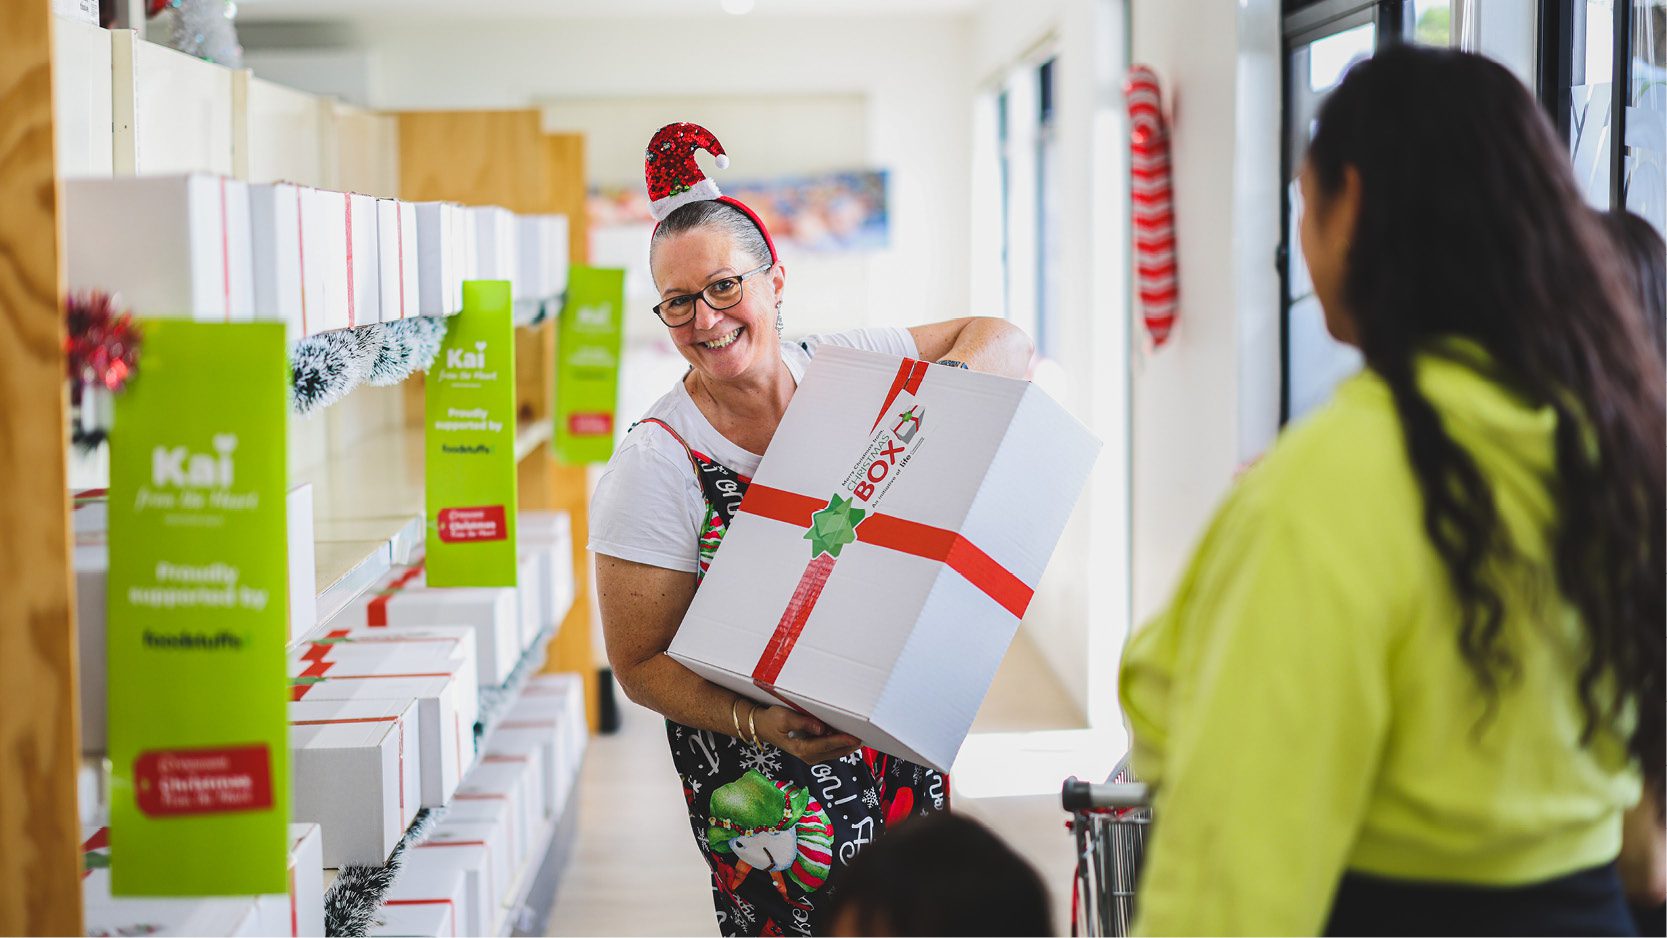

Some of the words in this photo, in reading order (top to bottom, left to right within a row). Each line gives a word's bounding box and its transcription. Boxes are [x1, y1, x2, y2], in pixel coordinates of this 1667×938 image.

[447, 341, 487, 368] Kai
[435, 419, 486, 431] supported
[489, 420, 503, 433] by
[448, 408, 488, 421] Proudly
[152, 433, 238, 487] Kai
[842, 471, 855, 486] Merry
[853, 443, 874, 470] Christmas
[847, 434, 890, 492] CHRISTMAS
[853, 439, 905, 502] BOX
[878, 476, 897, 500] initiative
[900, 454, 912, 468] life
[155, 561, 239, 589] Proudly
[128, 585, 235, 608] supported
[240, 585, 269, 611] by
